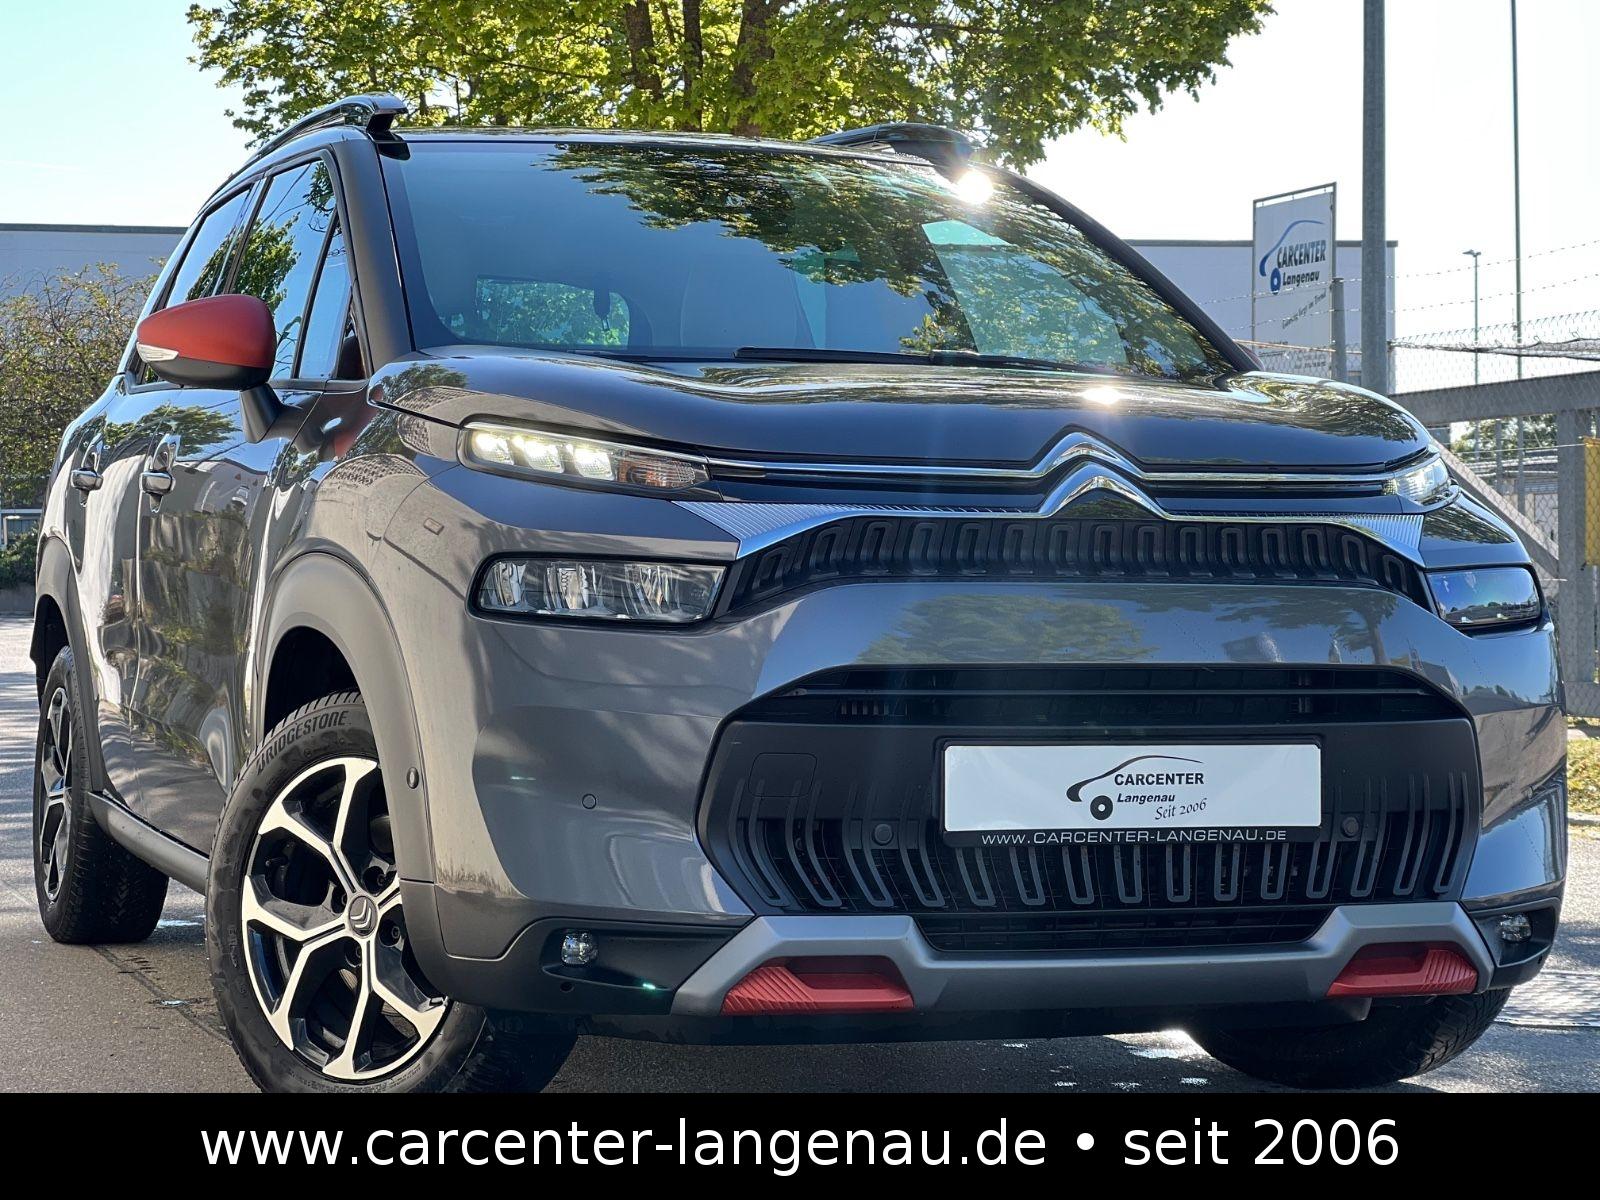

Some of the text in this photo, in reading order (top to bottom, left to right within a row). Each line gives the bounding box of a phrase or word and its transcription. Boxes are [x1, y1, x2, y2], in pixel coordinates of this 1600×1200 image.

[1277, 240, 1326, 268] CARCENTER
[1283, 271, 1320, 286] Langenau
[256, 711, 349, 775] BRIDGESTONE
[1114, 773, 1204, 785] CARCENTER
[1117, 793, 1175, 804] Langenau
[1155, 798, 1207, 820] Seit 2006
[981, 830, 1287, 845] WWW.CARCENTER-LANGENAU.DE
